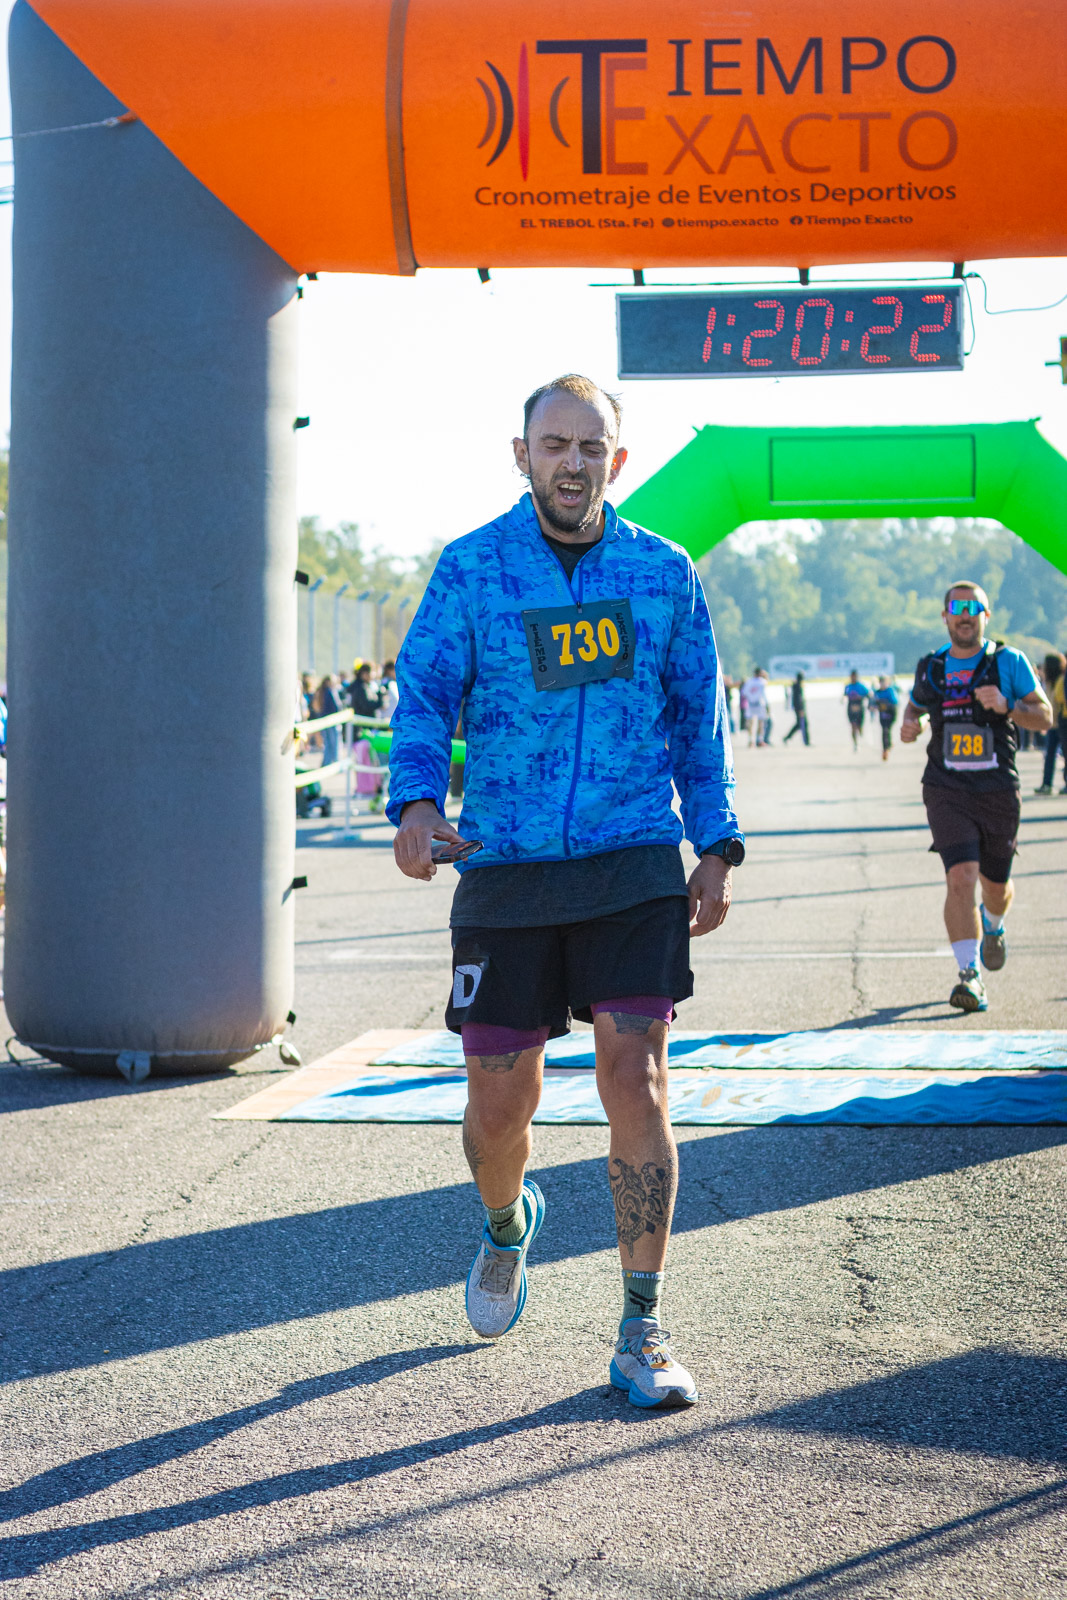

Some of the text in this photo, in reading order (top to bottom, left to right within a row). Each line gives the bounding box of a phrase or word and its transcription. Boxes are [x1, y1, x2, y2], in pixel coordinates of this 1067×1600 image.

[475, 182, 957, 209] Cronometraje de Eventos Deportivos
[520, 218, 537, 228] EL
[539, 218, 595, 228] TREBOL
[598, 218, 630, 229] (Sta.
[633, 217, 654, 229] Fe)
[805, 215, 861, 227] Tiempo
[864, 214, 914, 226] Exacto
[702, 294, 953, 367] 1:20:22
[529, 623, 548, 673] TIEMPO
[551, 617, 620, 666] 730
[615, 612, 629, 661] EXACTO
[952, 734, 984, 756] 738
